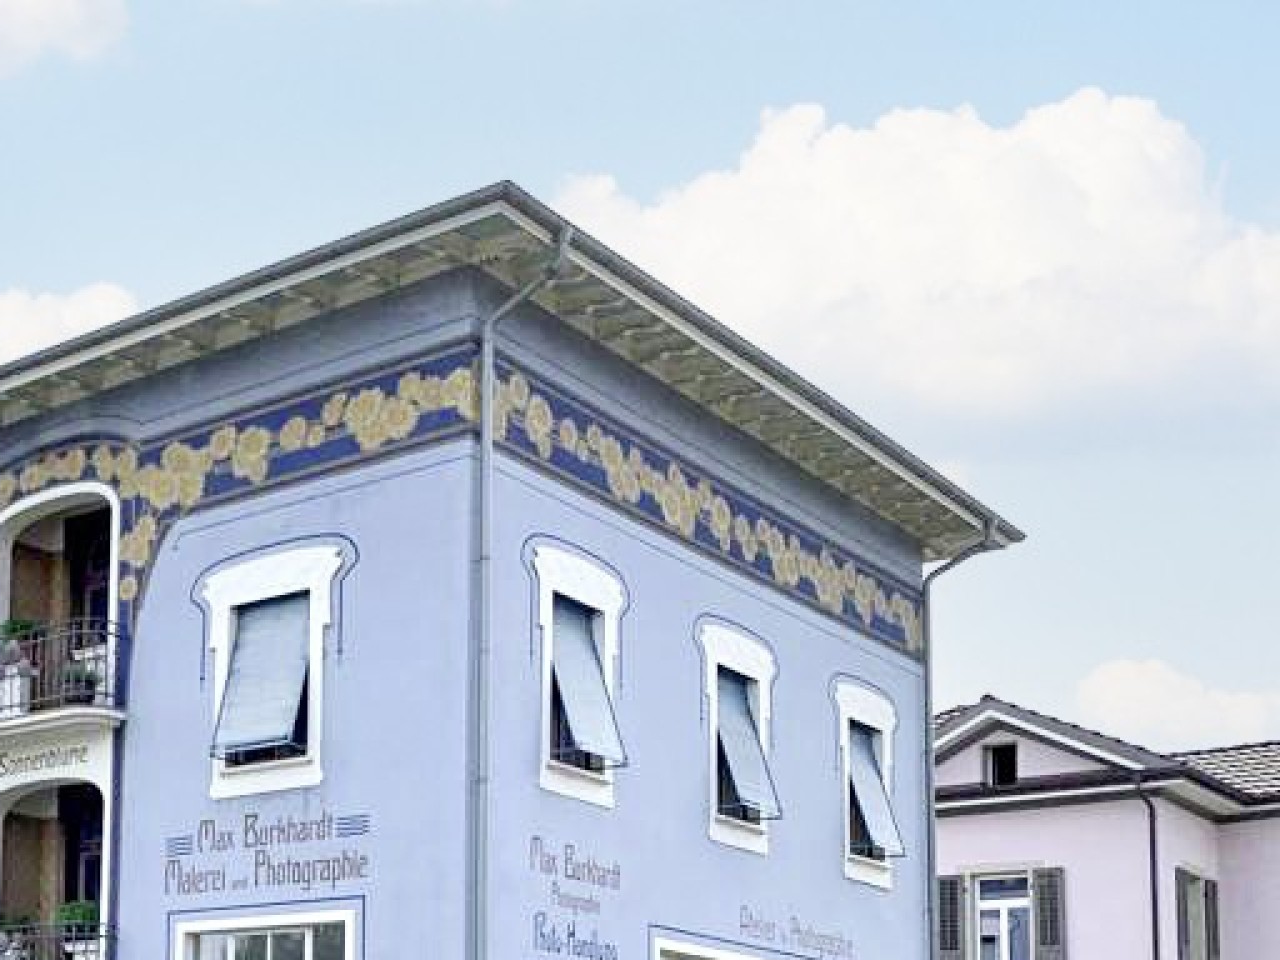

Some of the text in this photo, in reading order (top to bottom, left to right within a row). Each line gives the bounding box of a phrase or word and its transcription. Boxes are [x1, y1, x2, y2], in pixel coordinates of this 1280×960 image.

[0, 744, 88, 777] Sonnenblume
[197, 809, 333, 853] Max Burkhardt
[164, 859, 226, 895] Malerei
[254, 849, 369, 891] Photographie
